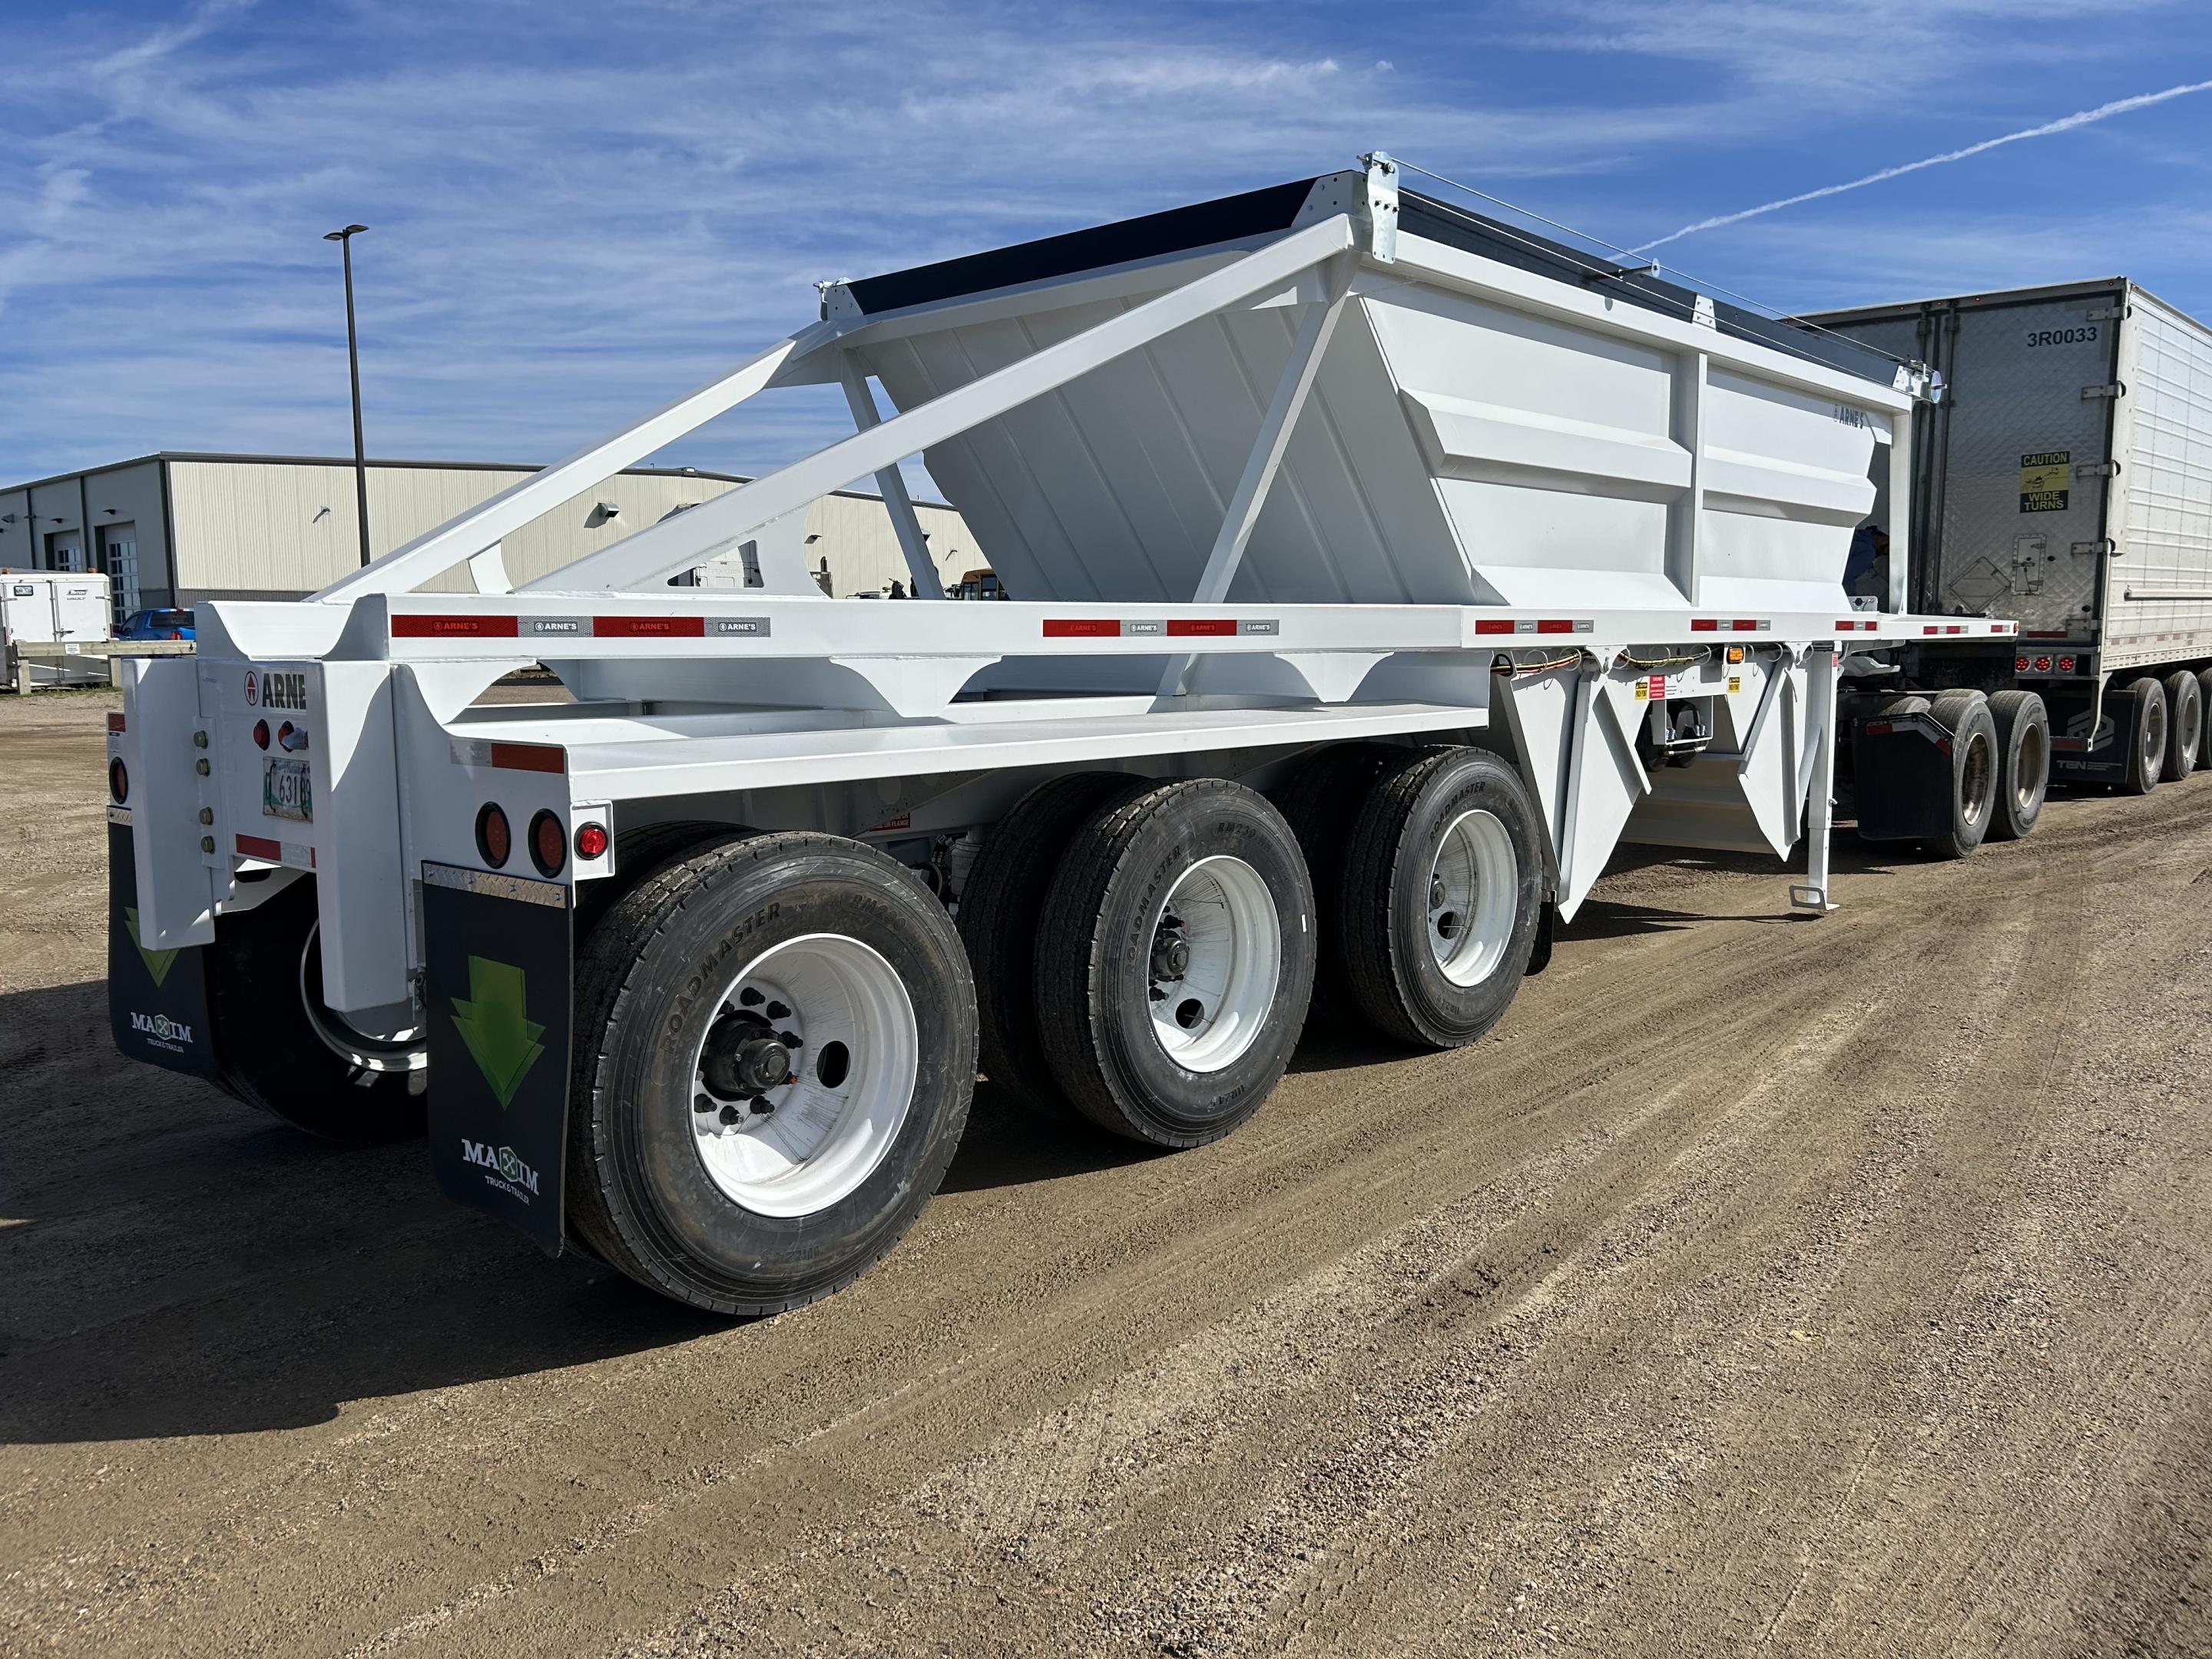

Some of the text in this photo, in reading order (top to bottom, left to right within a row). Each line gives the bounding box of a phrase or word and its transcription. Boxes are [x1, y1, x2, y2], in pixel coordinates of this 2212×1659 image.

[2027, 326, 2098, 347] 3R0033
[1839, 406, 1863, 429] ARNE'S
[2023, 452, 2068, 465] CAUTION
[2024, 500, 2065, 511] TURNS
[2028, 491, 2060, 502] WIDE
[1429, 781, 1485, 843] ROADMASTER
[1124, 845, 1182, 977] ROADMASTER
[660, 901, 782, 1055] ROADMASTER
[131, 1012, 194, 1043] MAXIM
[462, 1138, 539, 1196] MAXIM
